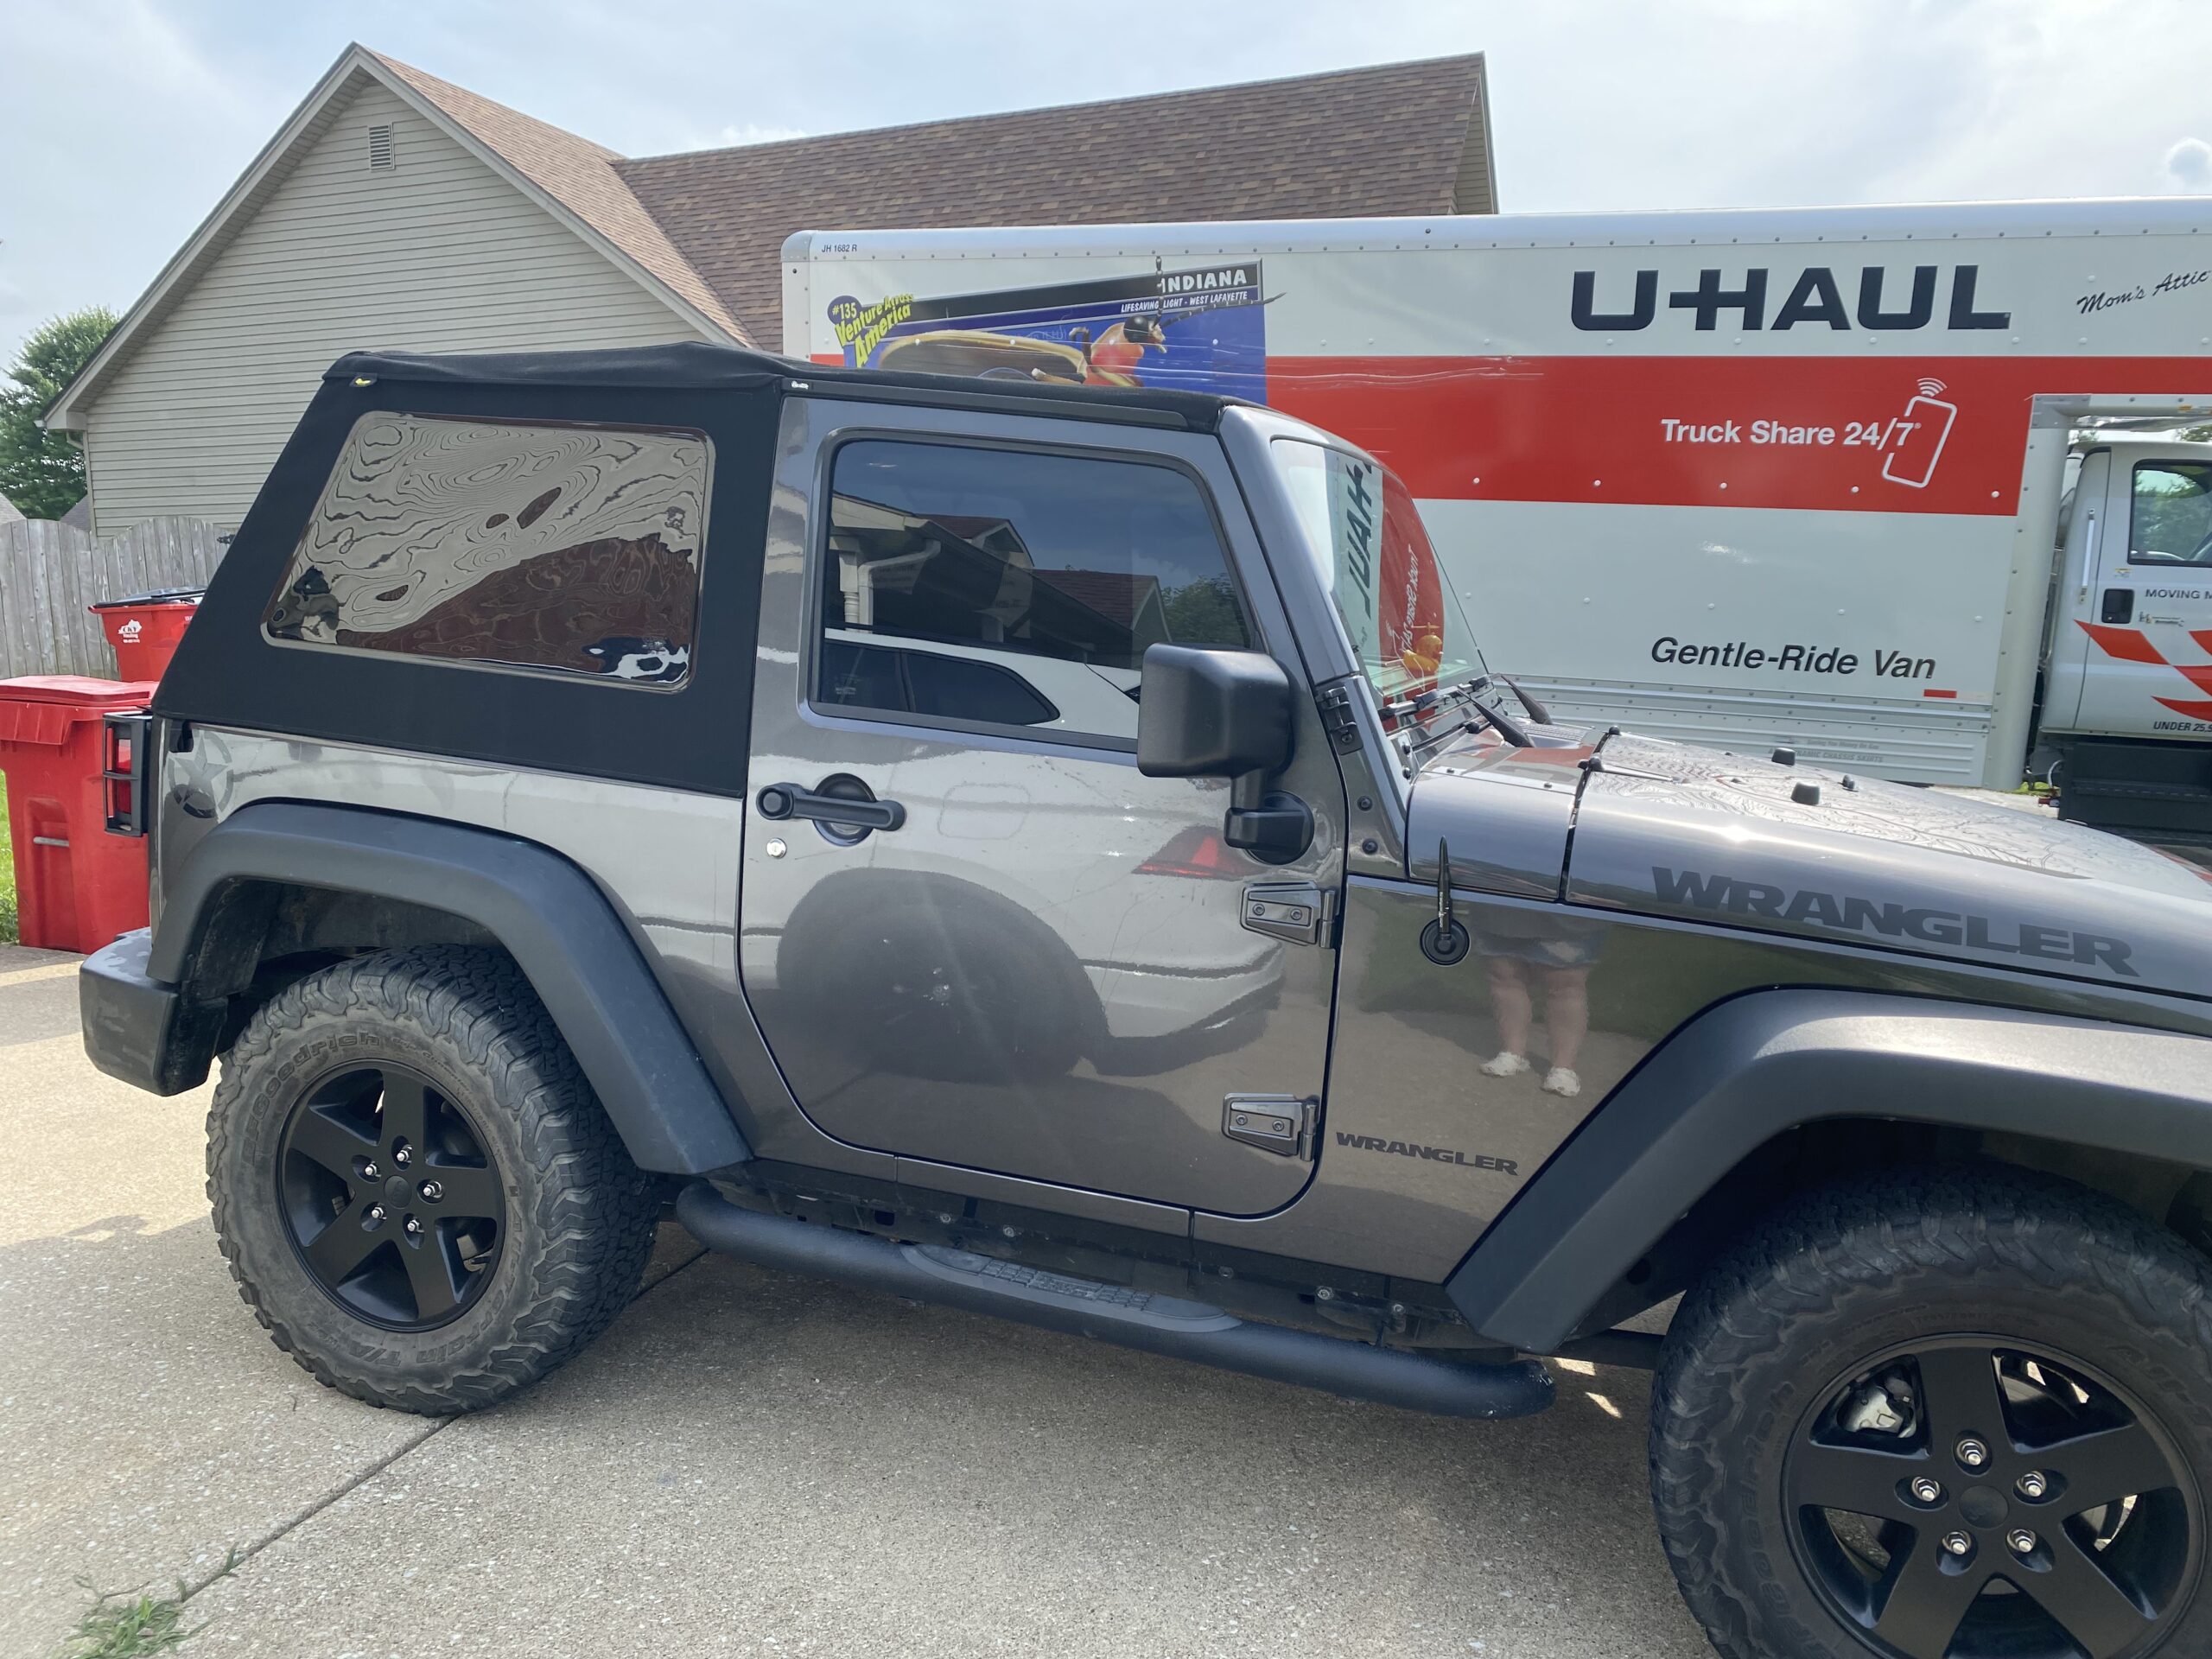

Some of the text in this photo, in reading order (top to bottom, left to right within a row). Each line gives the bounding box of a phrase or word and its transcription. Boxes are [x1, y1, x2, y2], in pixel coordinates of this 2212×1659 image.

[1160, 269, 1247, 293] INDIANA
[2076, 270, 2209, 314] Mom's Attic
[832, 302, 857, 320] #135
[1121, 301, 1159, 314] LIFESAVING
[1163, 297, 1183, 308] LIGHT
[1190, 295, 1209, 306] WEST
[1211, 290, 1248, 303] LAFAYETTE
[835, 292, 915, 347] Venture Across
[855, 304, 912, 368] America
[1661, 419, 1742, 443] Truck
[1750, 421, 1835, 446] Share
[2145, 588, 2200, 599] MOVING
[1651, 636, 1936, 679] Gentle-Ride Van
[2153, 721, 2191, 731] UNDER
[1822, 752, 1854, 760] CHASSIS
[1652, 866, 2139, 977] WRANGLER
[1336, 1132, 1519, 1176] WRANGLER
